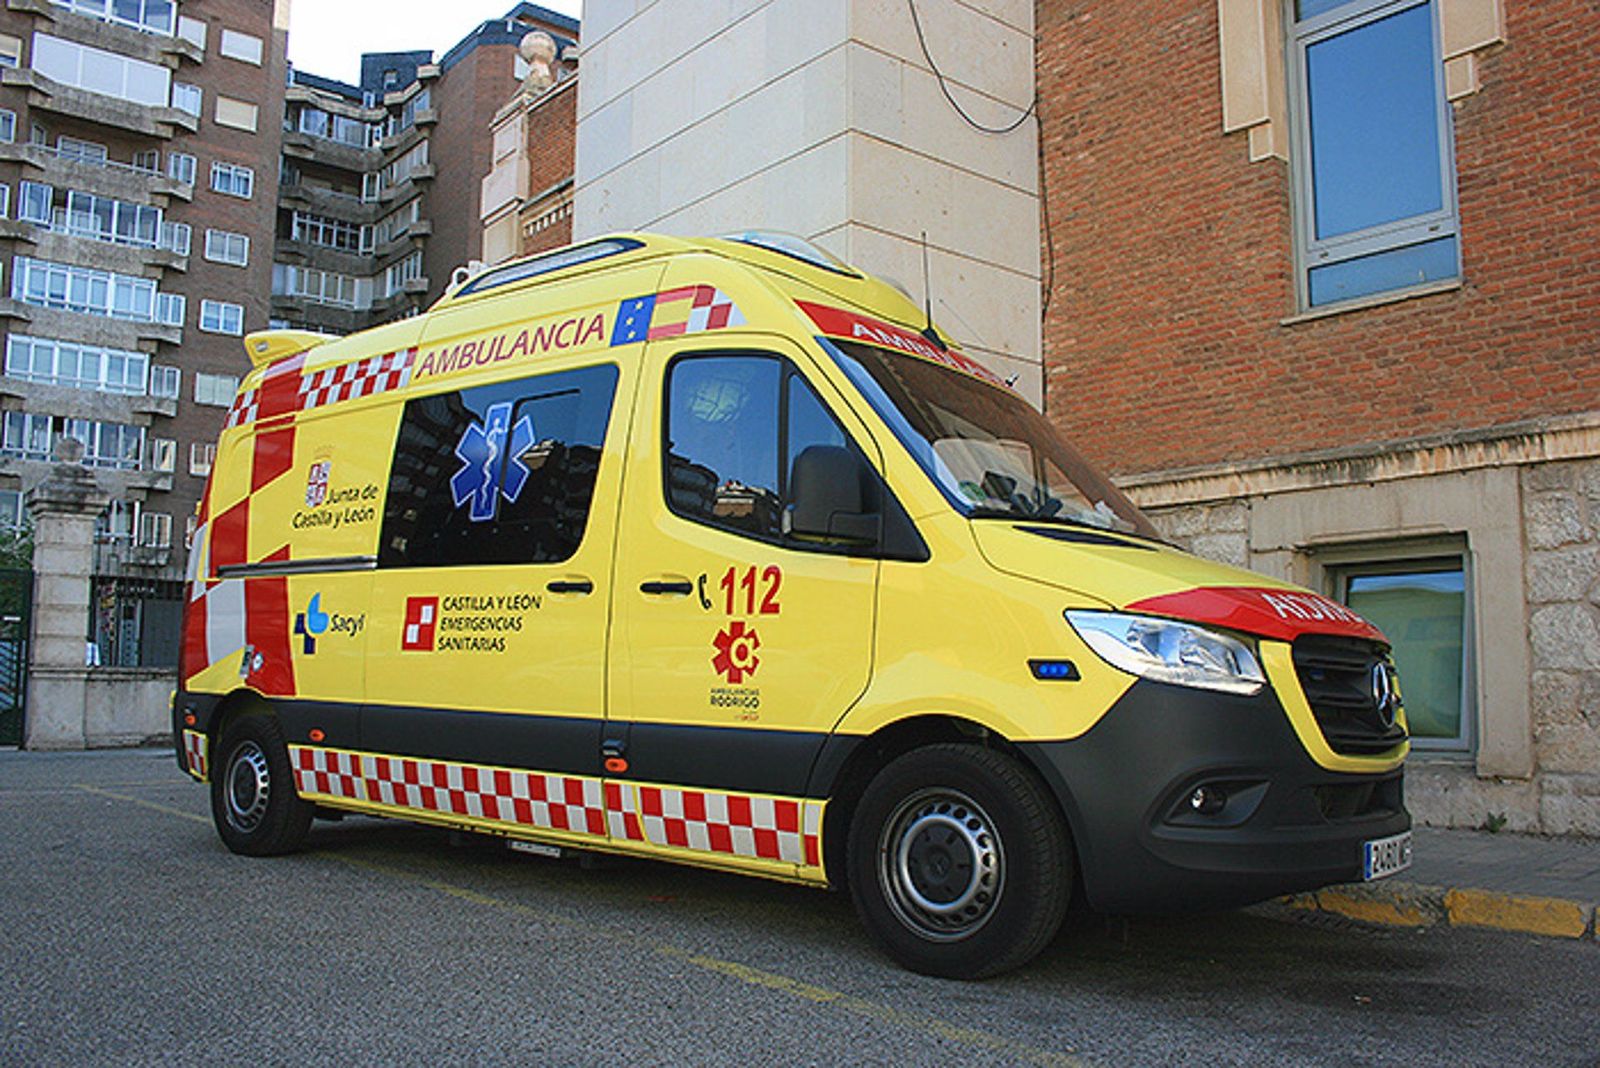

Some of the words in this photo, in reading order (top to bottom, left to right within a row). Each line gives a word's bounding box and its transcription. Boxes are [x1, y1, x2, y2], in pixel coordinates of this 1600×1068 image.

[413, 312, 606, 380] AMBULANCIA
[326, 488, 360, 505] Junta
[361, 484, 379, 500] de
[292, 508, 333, 529] Castilla
[333, 511, 343, 529] y
[720, 564, 782, 616] 112
[442, 596, 495, 612] CASTILLA
[496, 596, 506, 610] Y
[330, 613, 366, 638] Sacyl
[440, 615, 523, 632] EMERGENCIAS
[438, 636, 507, 652] SANITARIAS
[710, 695, 761, 709] RODRIGO
